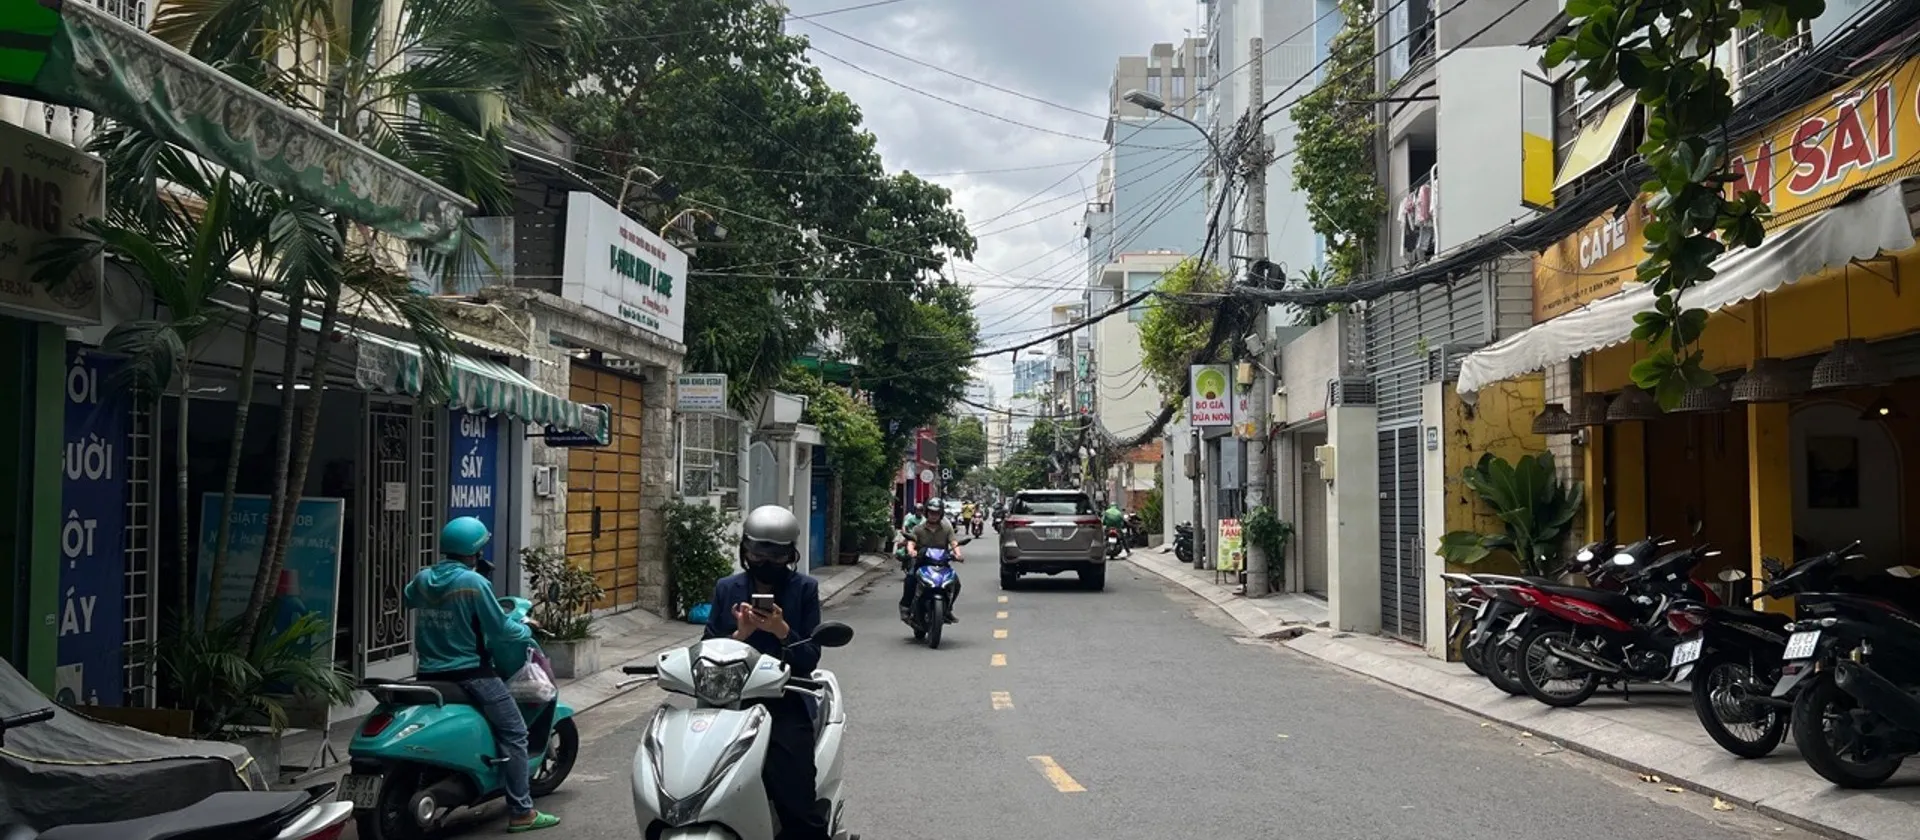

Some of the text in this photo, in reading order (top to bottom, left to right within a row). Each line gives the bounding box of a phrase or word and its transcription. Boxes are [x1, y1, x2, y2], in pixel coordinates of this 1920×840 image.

[451, 485, 492, 508] NHANH
[62, 509, 97, 569] ỘT
[60, 586, 97, 637] ÁY
